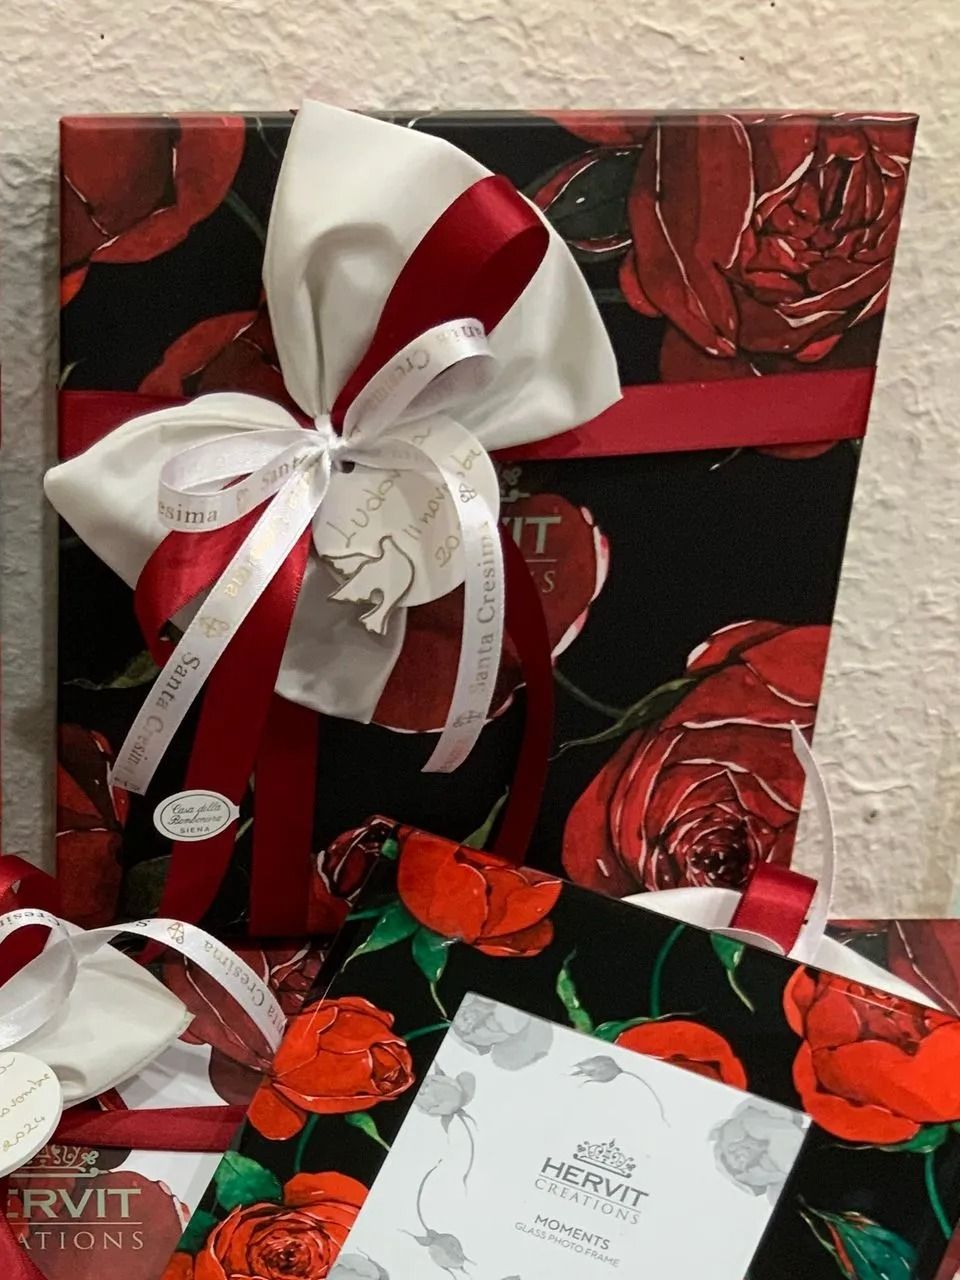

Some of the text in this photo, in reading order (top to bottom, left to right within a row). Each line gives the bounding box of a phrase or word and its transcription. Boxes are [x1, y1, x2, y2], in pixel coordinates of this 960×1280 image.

[158, 502, 219, 524] esima
[155, 651, 202, 710] Santa
[179, 826, 211, 835] SIENA
[203, 939, 266, 1007] Cresima
[533, 1177, 641, 1226] CREATIONS
[540, 1156, 650, 1208] HERVIT
[5, 1188, 142, 1220] ERVIT
[18, 1230, 145, 1251] ATIONS
[514, 1221, 621, 1269] GLASS PHOTO FRAME
[533, 1213, 612, 1251] MOMENTS
